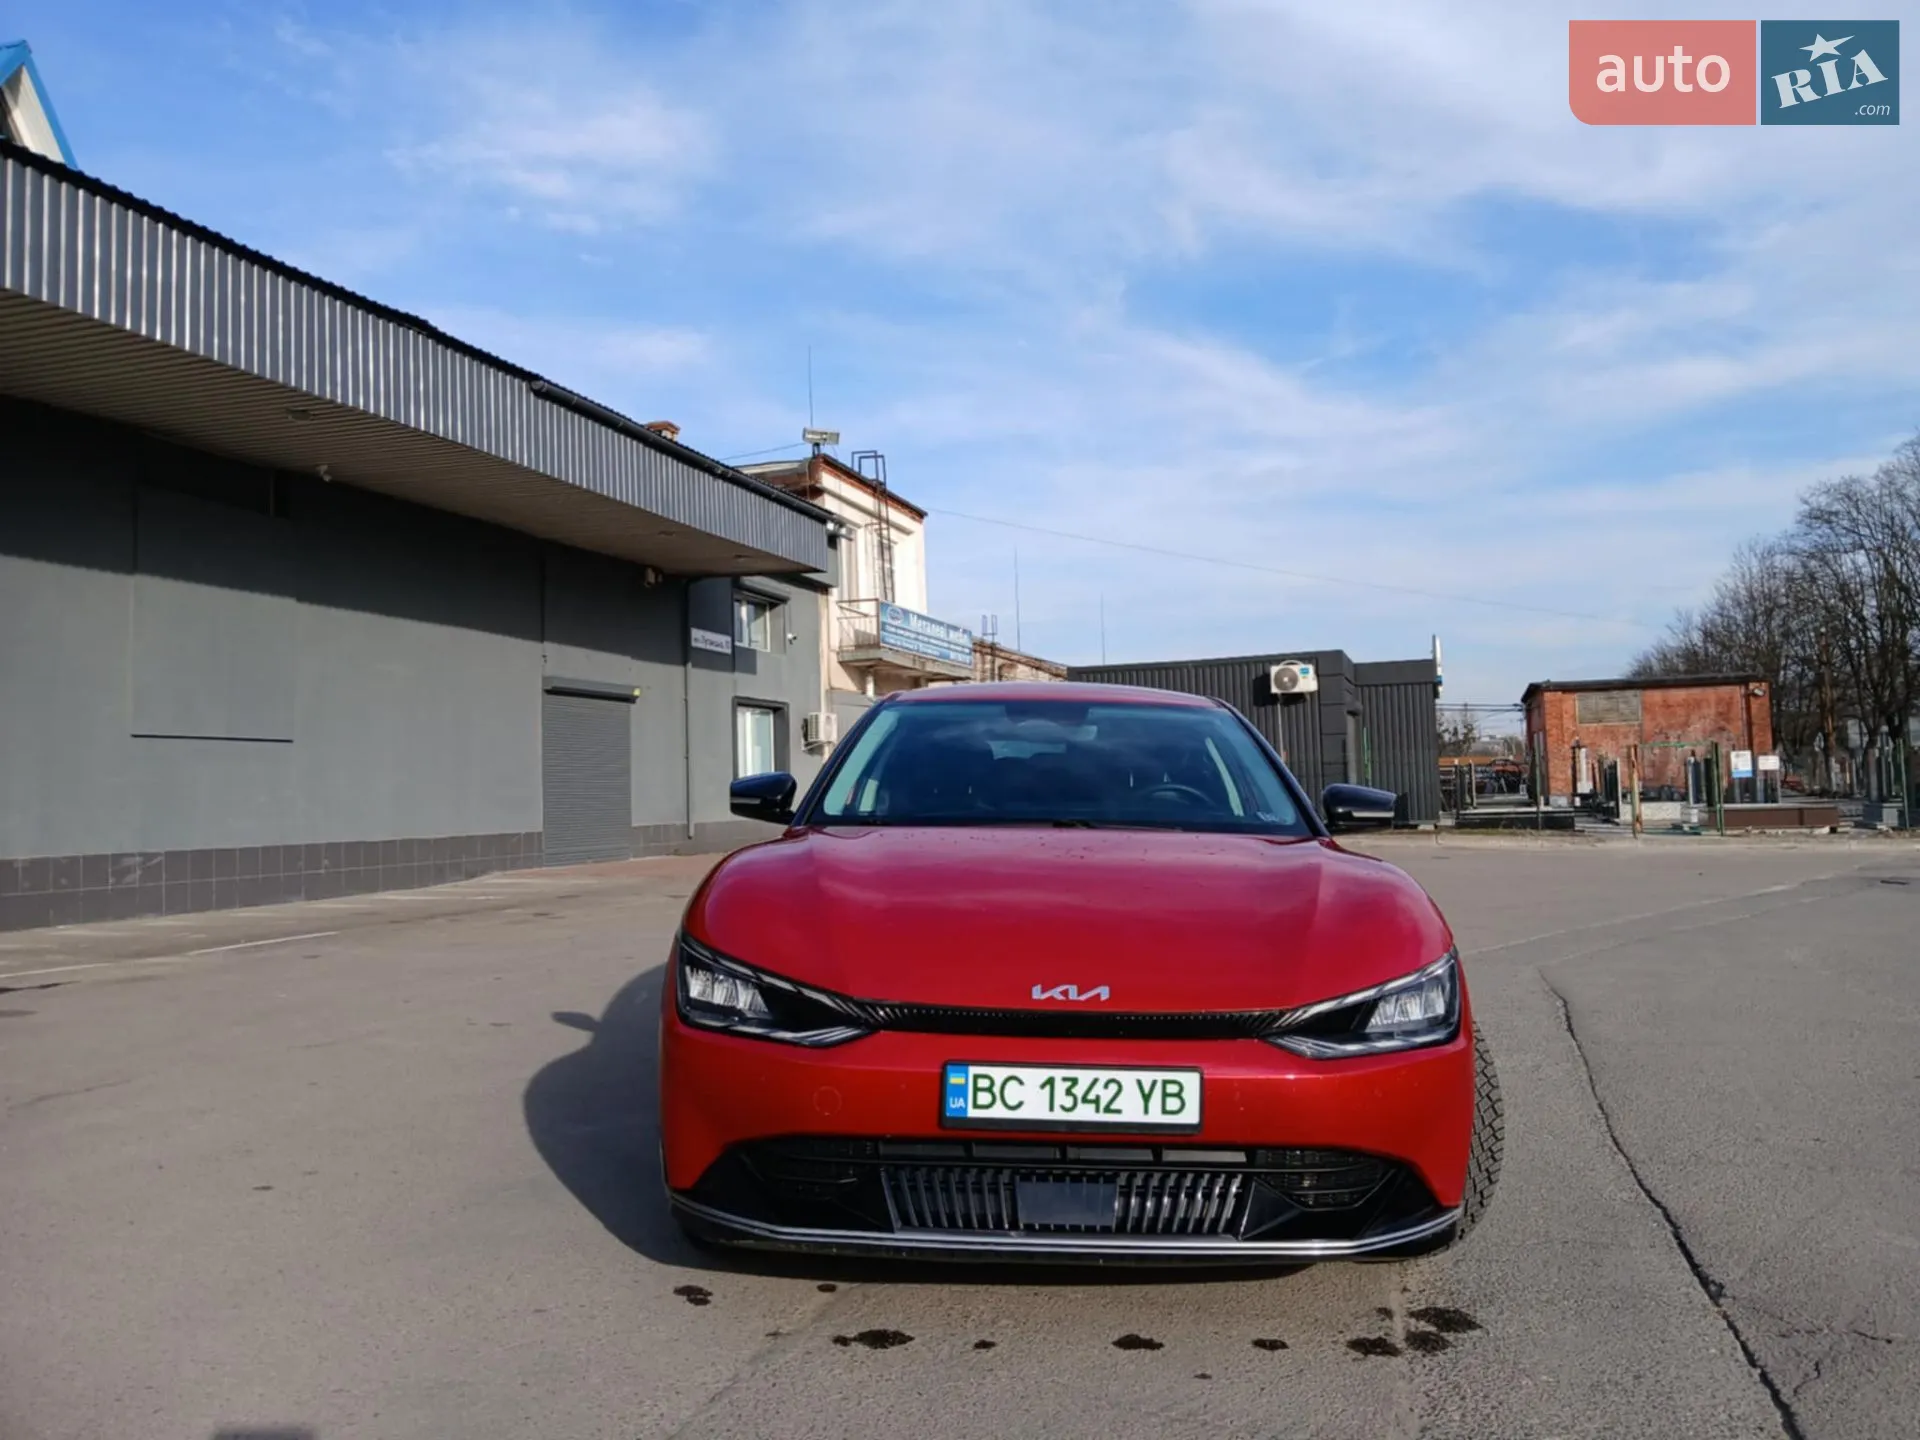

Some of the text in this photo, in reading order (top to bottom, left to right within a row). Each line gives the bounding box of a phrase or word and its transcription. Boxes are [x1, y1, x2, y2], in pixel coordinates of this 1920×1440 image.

[1031, 984, 1110, 1001] KIA
[949, 1097, 966, 1108] UA
[972, 1074, 1187, 1115] BC 1342 YB
